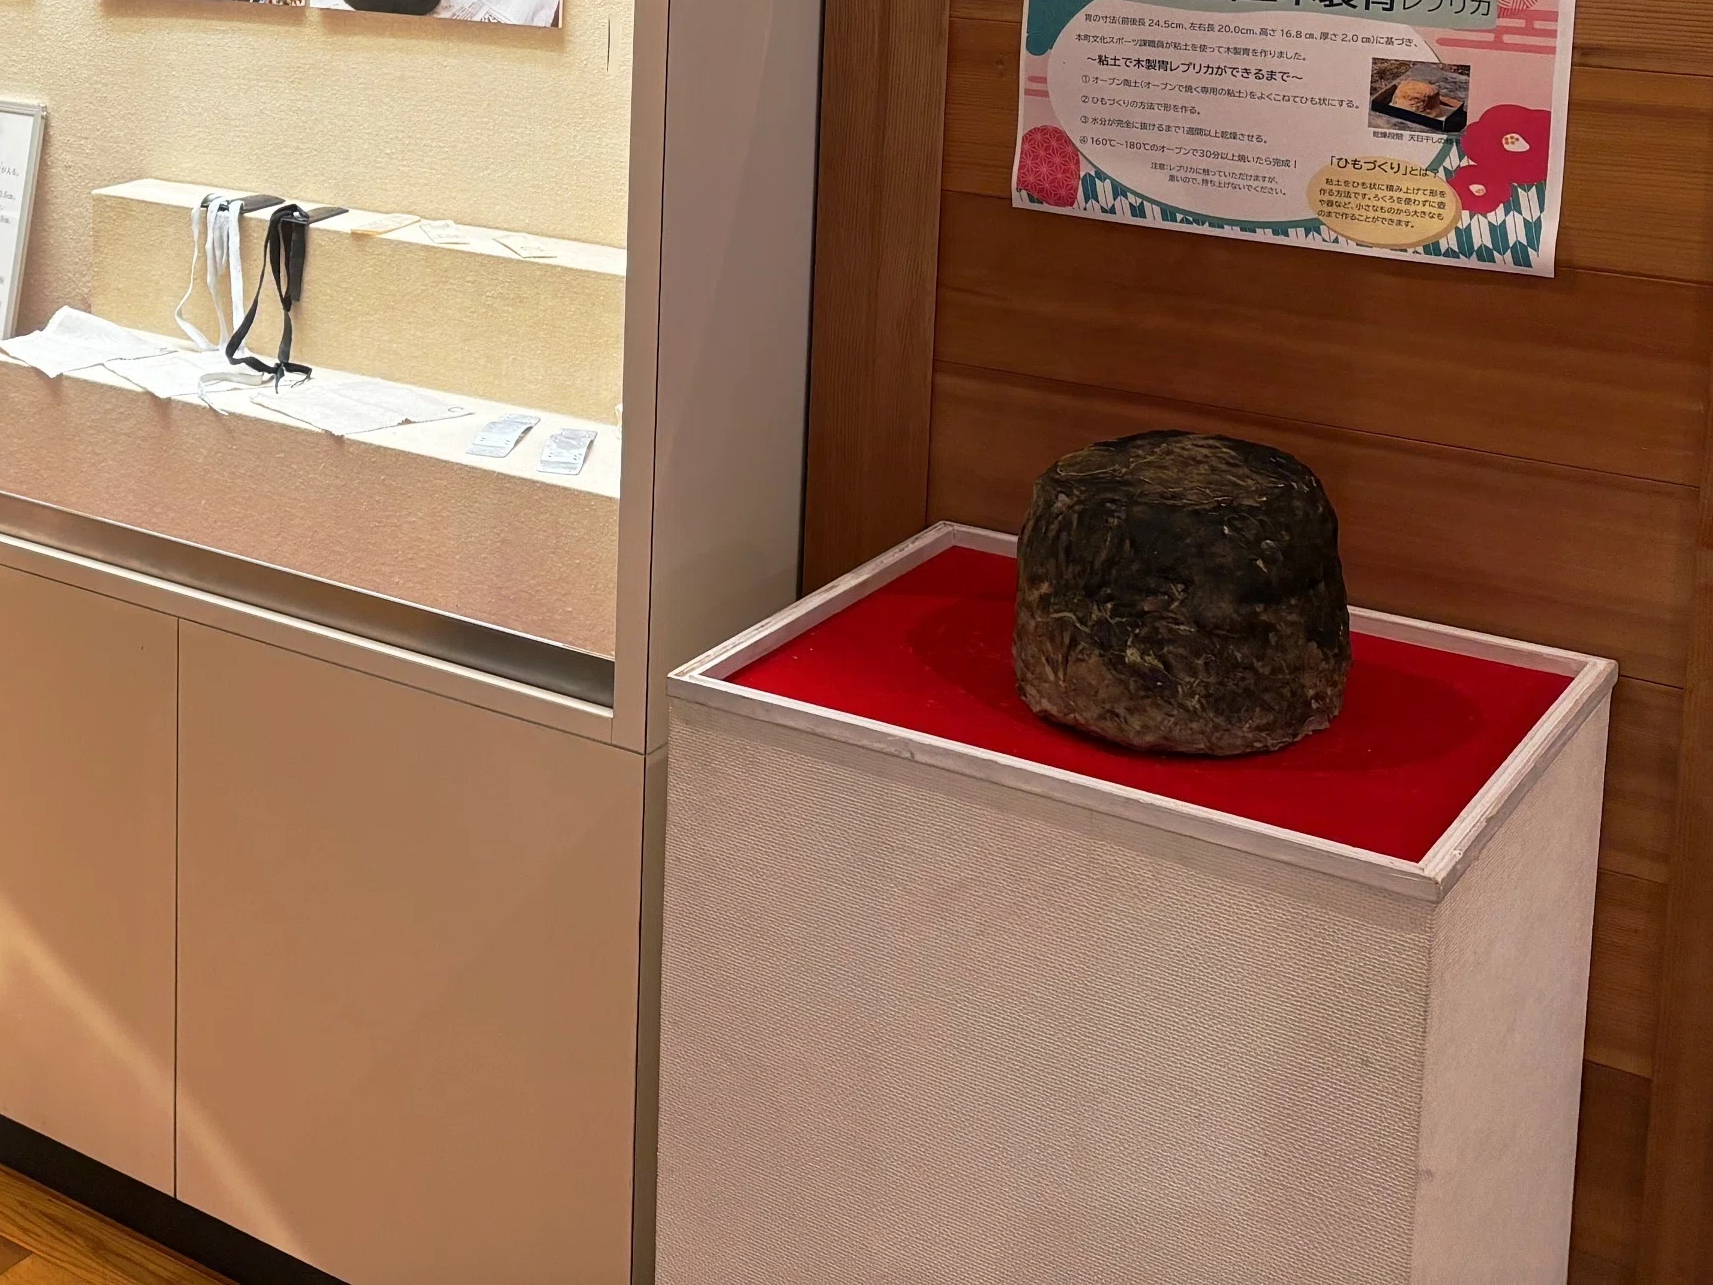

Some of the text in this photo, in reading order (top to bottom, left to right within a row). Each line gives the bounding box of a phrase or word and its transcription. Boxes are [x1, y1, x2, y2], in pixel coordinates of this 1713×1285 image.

[1325, 177, 1447, 198] 粘土をひも状に積み上げて形を
[1319, 188, 1447, 210] 作る方法です。ろくろを使わずに壺
[1317, 209, 1415, 229] のまで作ることができます。
